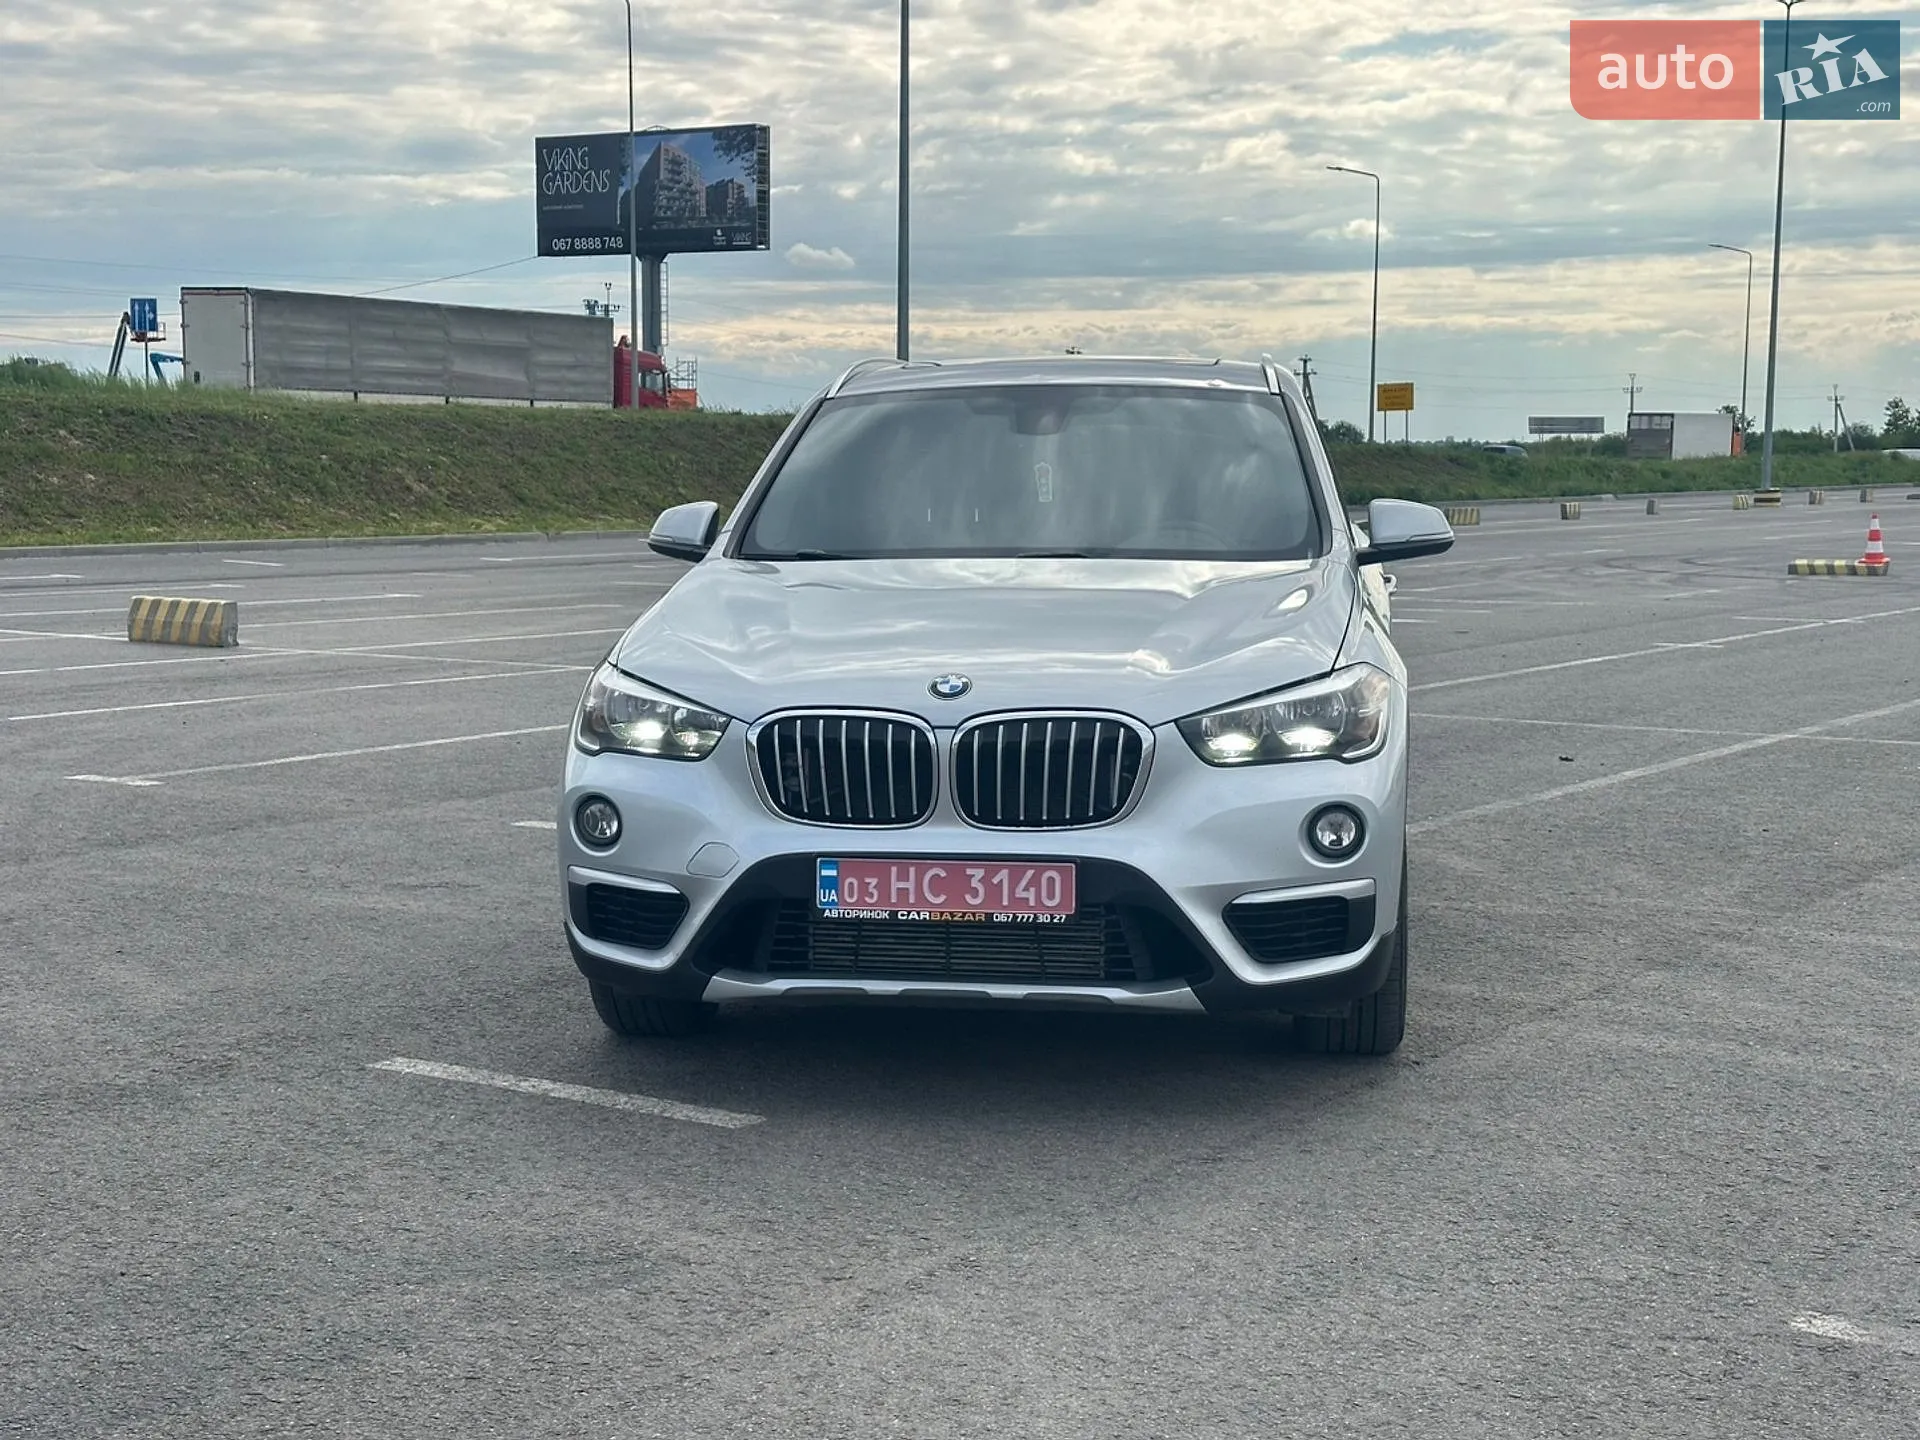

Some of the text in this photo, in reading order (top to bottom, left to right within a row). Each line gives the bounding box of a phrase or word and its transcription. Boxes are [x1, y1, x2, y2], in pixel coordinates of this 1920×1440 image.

[542, 170, 610, 195] GARDENS
[552, 236, 624, 251] 067 8888 748
[843, 877, 879, 904] 03
[964, 868, 1062, 907] 3140
[820, 889, 838, 902] UA
[823, 908, 890, 920] АВТОРИНОК
[993, 912, 1013, 922] 067
[1015, 913, 1034, 922] 777
[1036, 914, 1051, 923] 30
[1052, 914, 1066, 923] 27
